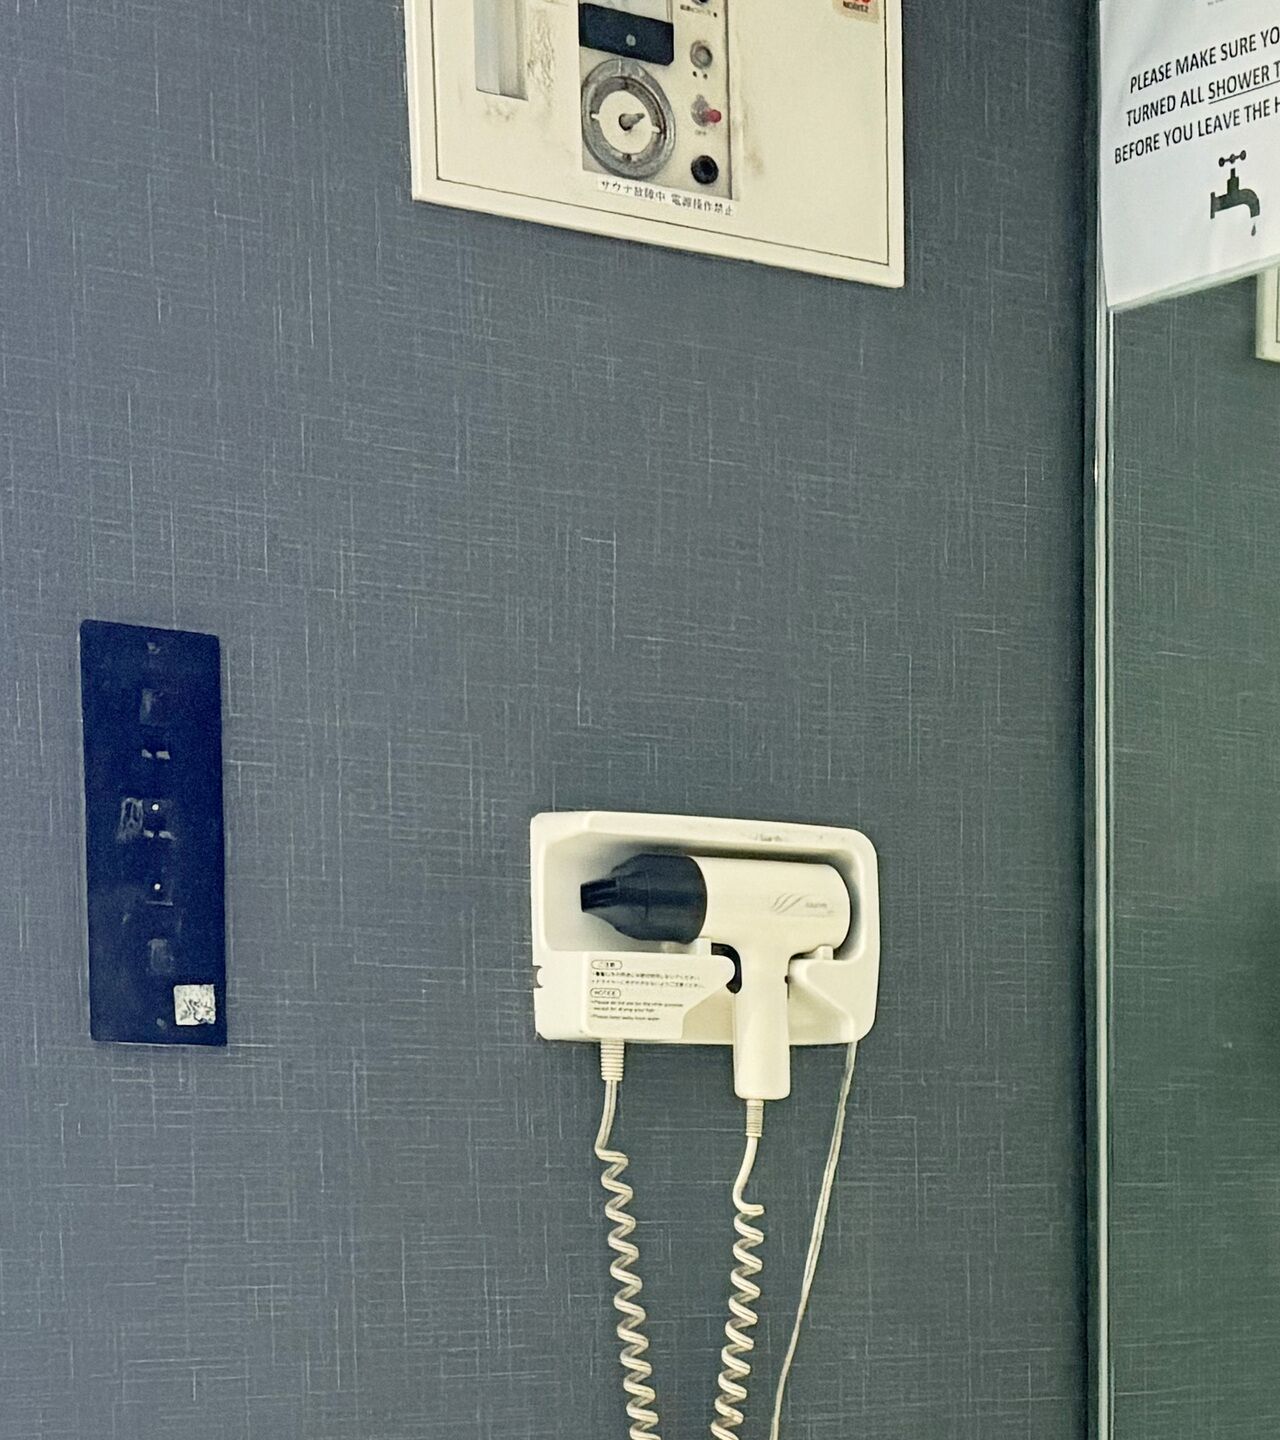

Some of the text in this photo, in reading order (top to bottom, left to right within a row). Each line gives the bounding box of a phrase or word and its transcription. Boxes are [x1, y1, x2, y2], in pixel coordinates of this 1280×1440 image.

[1130, 61, 1172, 94] PLEASE
[1175, 46, 1217, 76] MAKE
[1220, 34, 1257, 61] SURE
[1126, 95, 1176, 127] TURNED
[1180, 85, 1205, 109] ALL
[1208, 65, 1270, 100] SHOWER
[1114, 133, 1160, 164] BEFORE
[1163, 123, 1194, 148] YOU
[1197, 108, 1241, 138] LEAVE
[1244, 98, 1271, 123] THE
